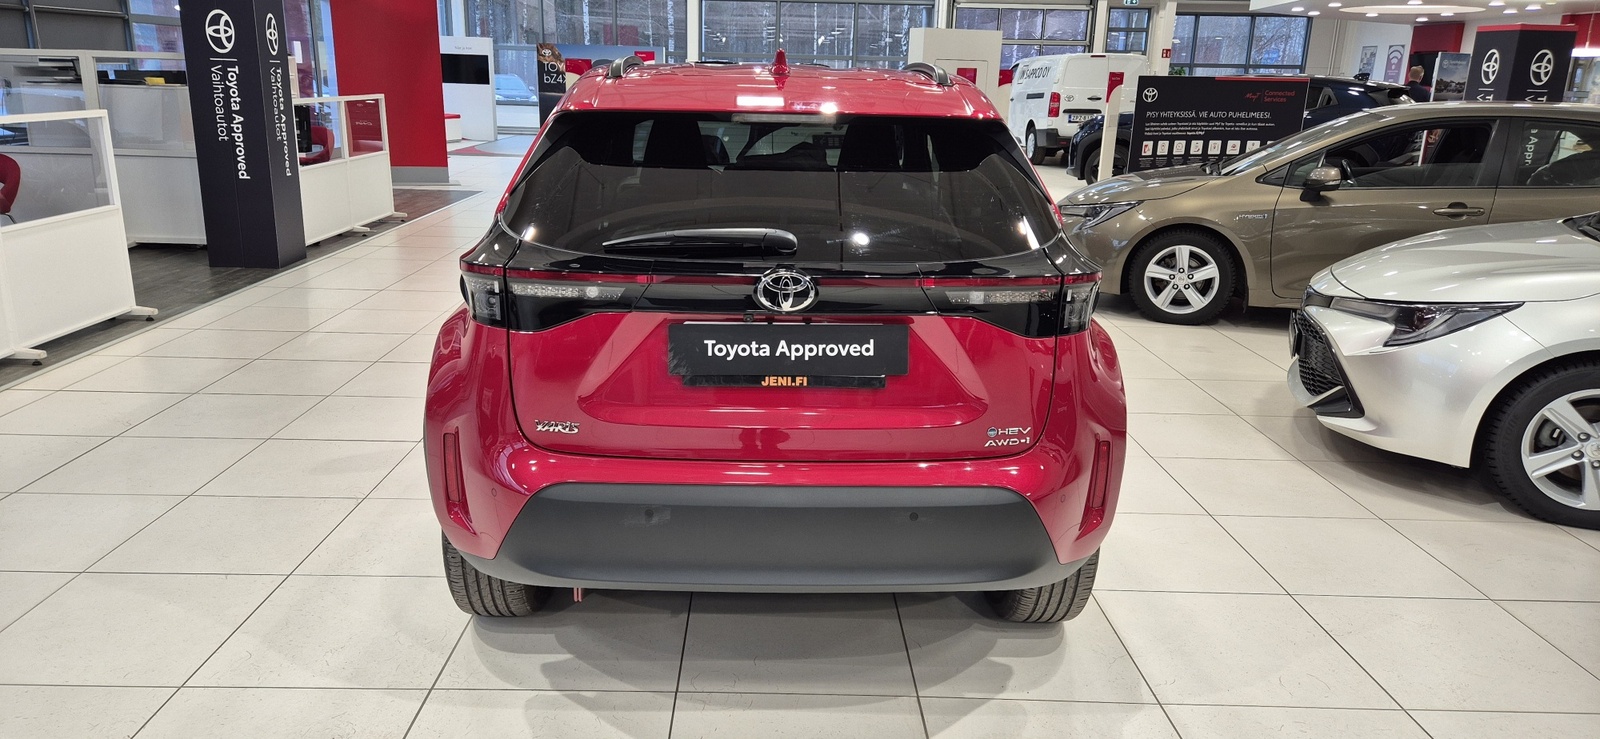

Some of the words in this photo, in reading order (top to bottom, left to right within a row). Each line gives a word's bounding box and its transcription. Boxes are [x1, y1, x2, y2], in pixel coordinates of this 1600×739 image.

[543, 62, 566, 72] TOY
[210, 65, 229, 141] Vaihtoautot
[225, 65, 242, 111] Toyota
[269, 67, 282, 141] Vaihtoautot
[276, 67, 285, 111] Toyota
[1228, 111, 1272, 119] PUHELIMEESI.
[230, 113, 251, 180] Approved
[280, 113, 292, 177] Approved
[703, 339, 771, 361] Toyota
[775, 338, 875, 361] Approved
[761, 376, 808, 387] JENI.FI
[534, 419, 580, 434] YARIS
[998, 426, 1032, 436] HEV
